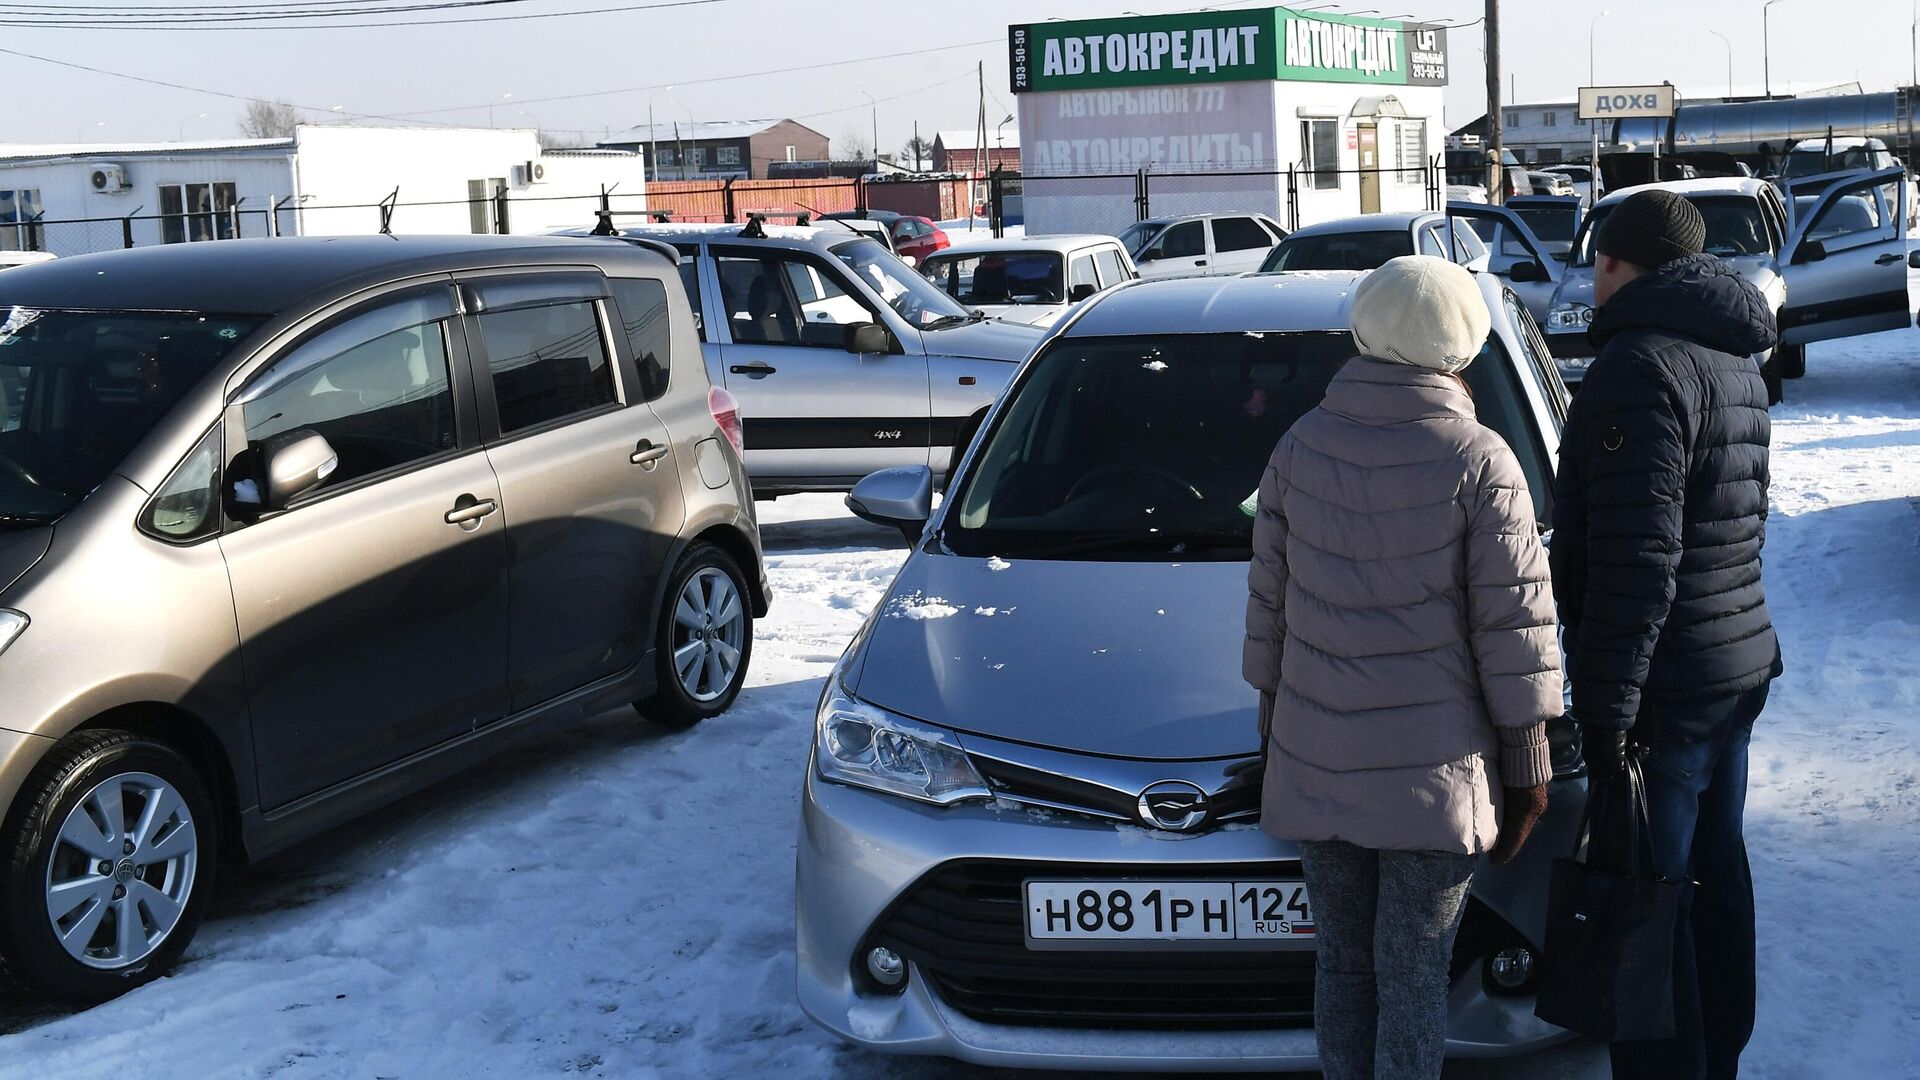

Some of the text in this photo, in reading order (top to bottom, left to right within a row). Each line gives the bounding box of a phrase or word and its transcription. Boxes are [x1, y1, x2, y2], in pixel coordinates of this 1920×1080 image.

[1014, 30, 1026, 87] 293-50-50
[1043, 26, 1259, 77] АВТОКРЕДИТ
[1284, 18, 1397, 76] АВТОКРЕДИТ
[1412, 64, 1445, 79] 293-50-50
[1059, 85, 1225, 118] АВТОРЫНОК 777
[1033, 131, 1263, 176] АВТОКРЕДИТЫ
[1045, 887, 1308, 932] Н881РН 124
[1255, 921, 1290, 933] RUS
